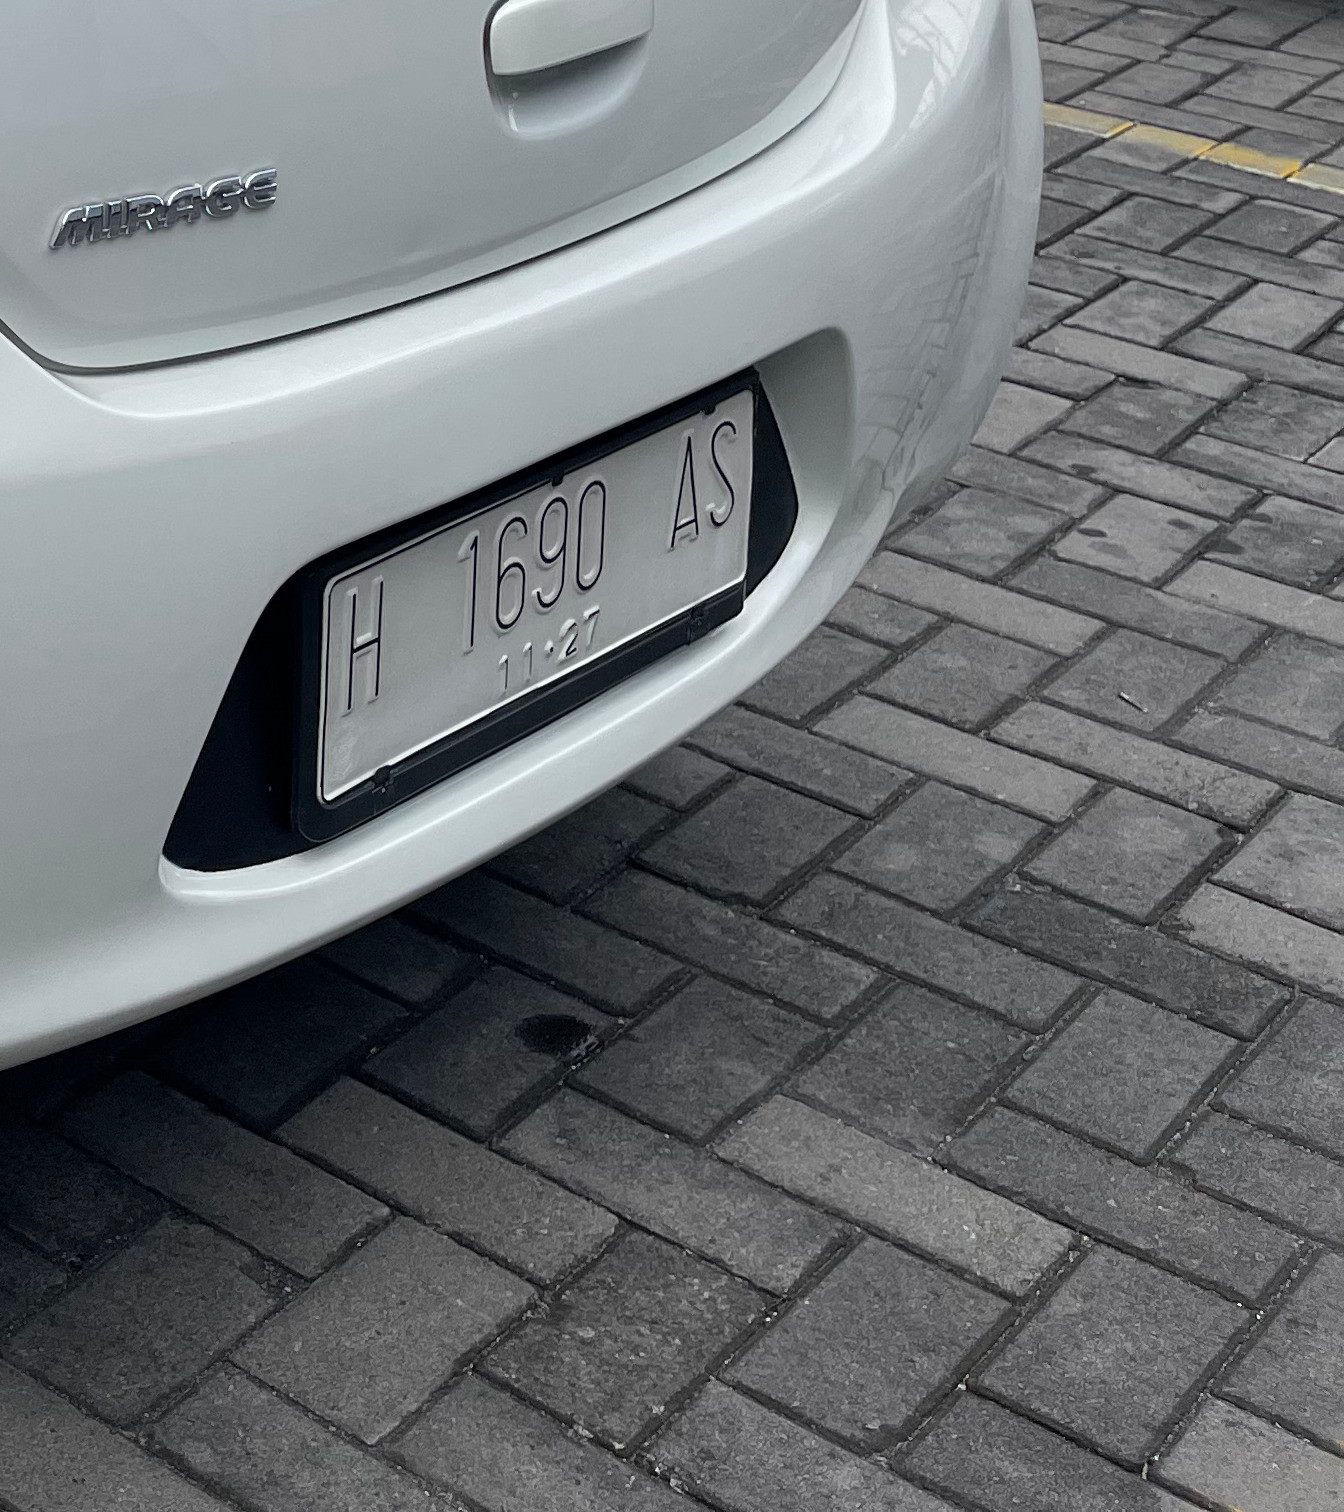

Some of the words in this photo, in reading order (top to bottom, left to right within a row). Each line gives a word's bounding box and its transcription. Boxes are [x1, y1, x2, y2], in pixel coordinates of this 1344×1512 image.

[48, 167, 278, 250] MIRAGE
[341, 575, 385, 717] H
[457, 475, 607, 654] 1690
[668, 419, 738, 551] AS
